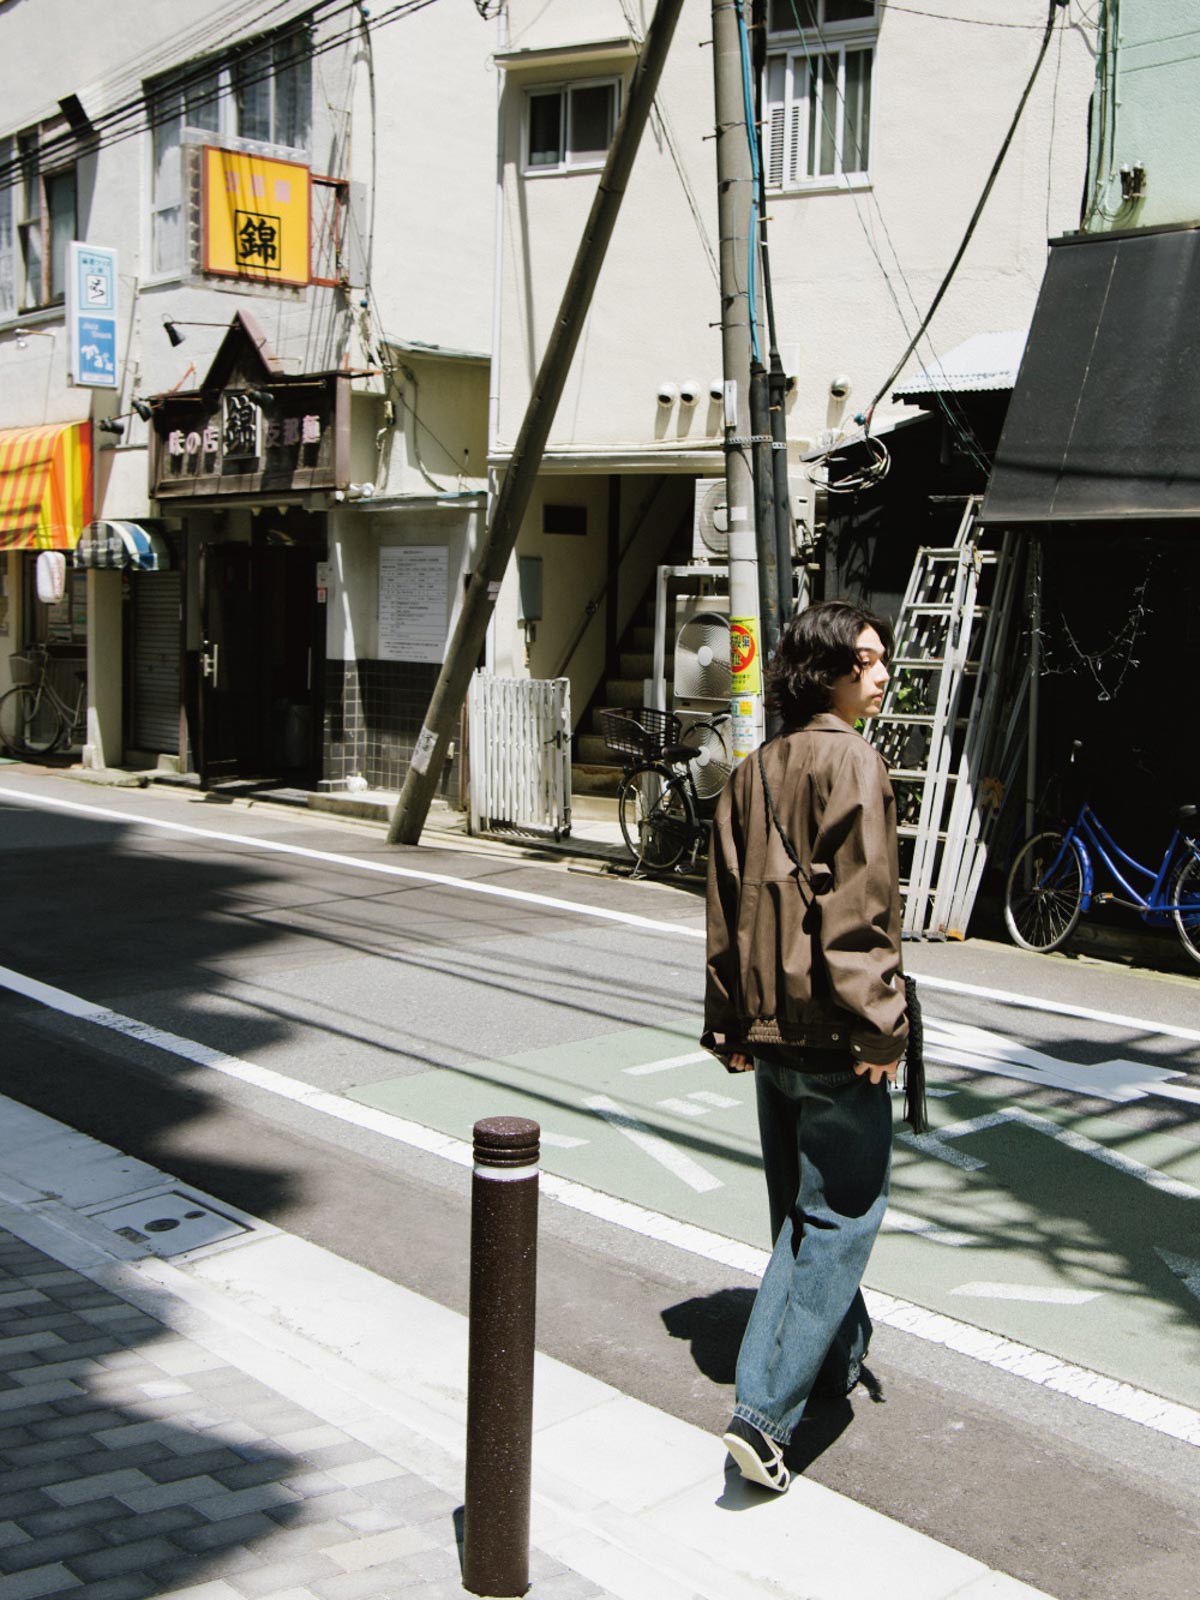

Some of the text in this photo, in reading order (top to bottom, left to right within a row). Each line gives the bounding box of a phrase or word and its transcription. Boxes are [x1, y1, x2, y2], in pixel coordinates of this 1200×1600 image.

[238, 216, 276, 265] 錦
[168, 425, 220, 456] 味の店
